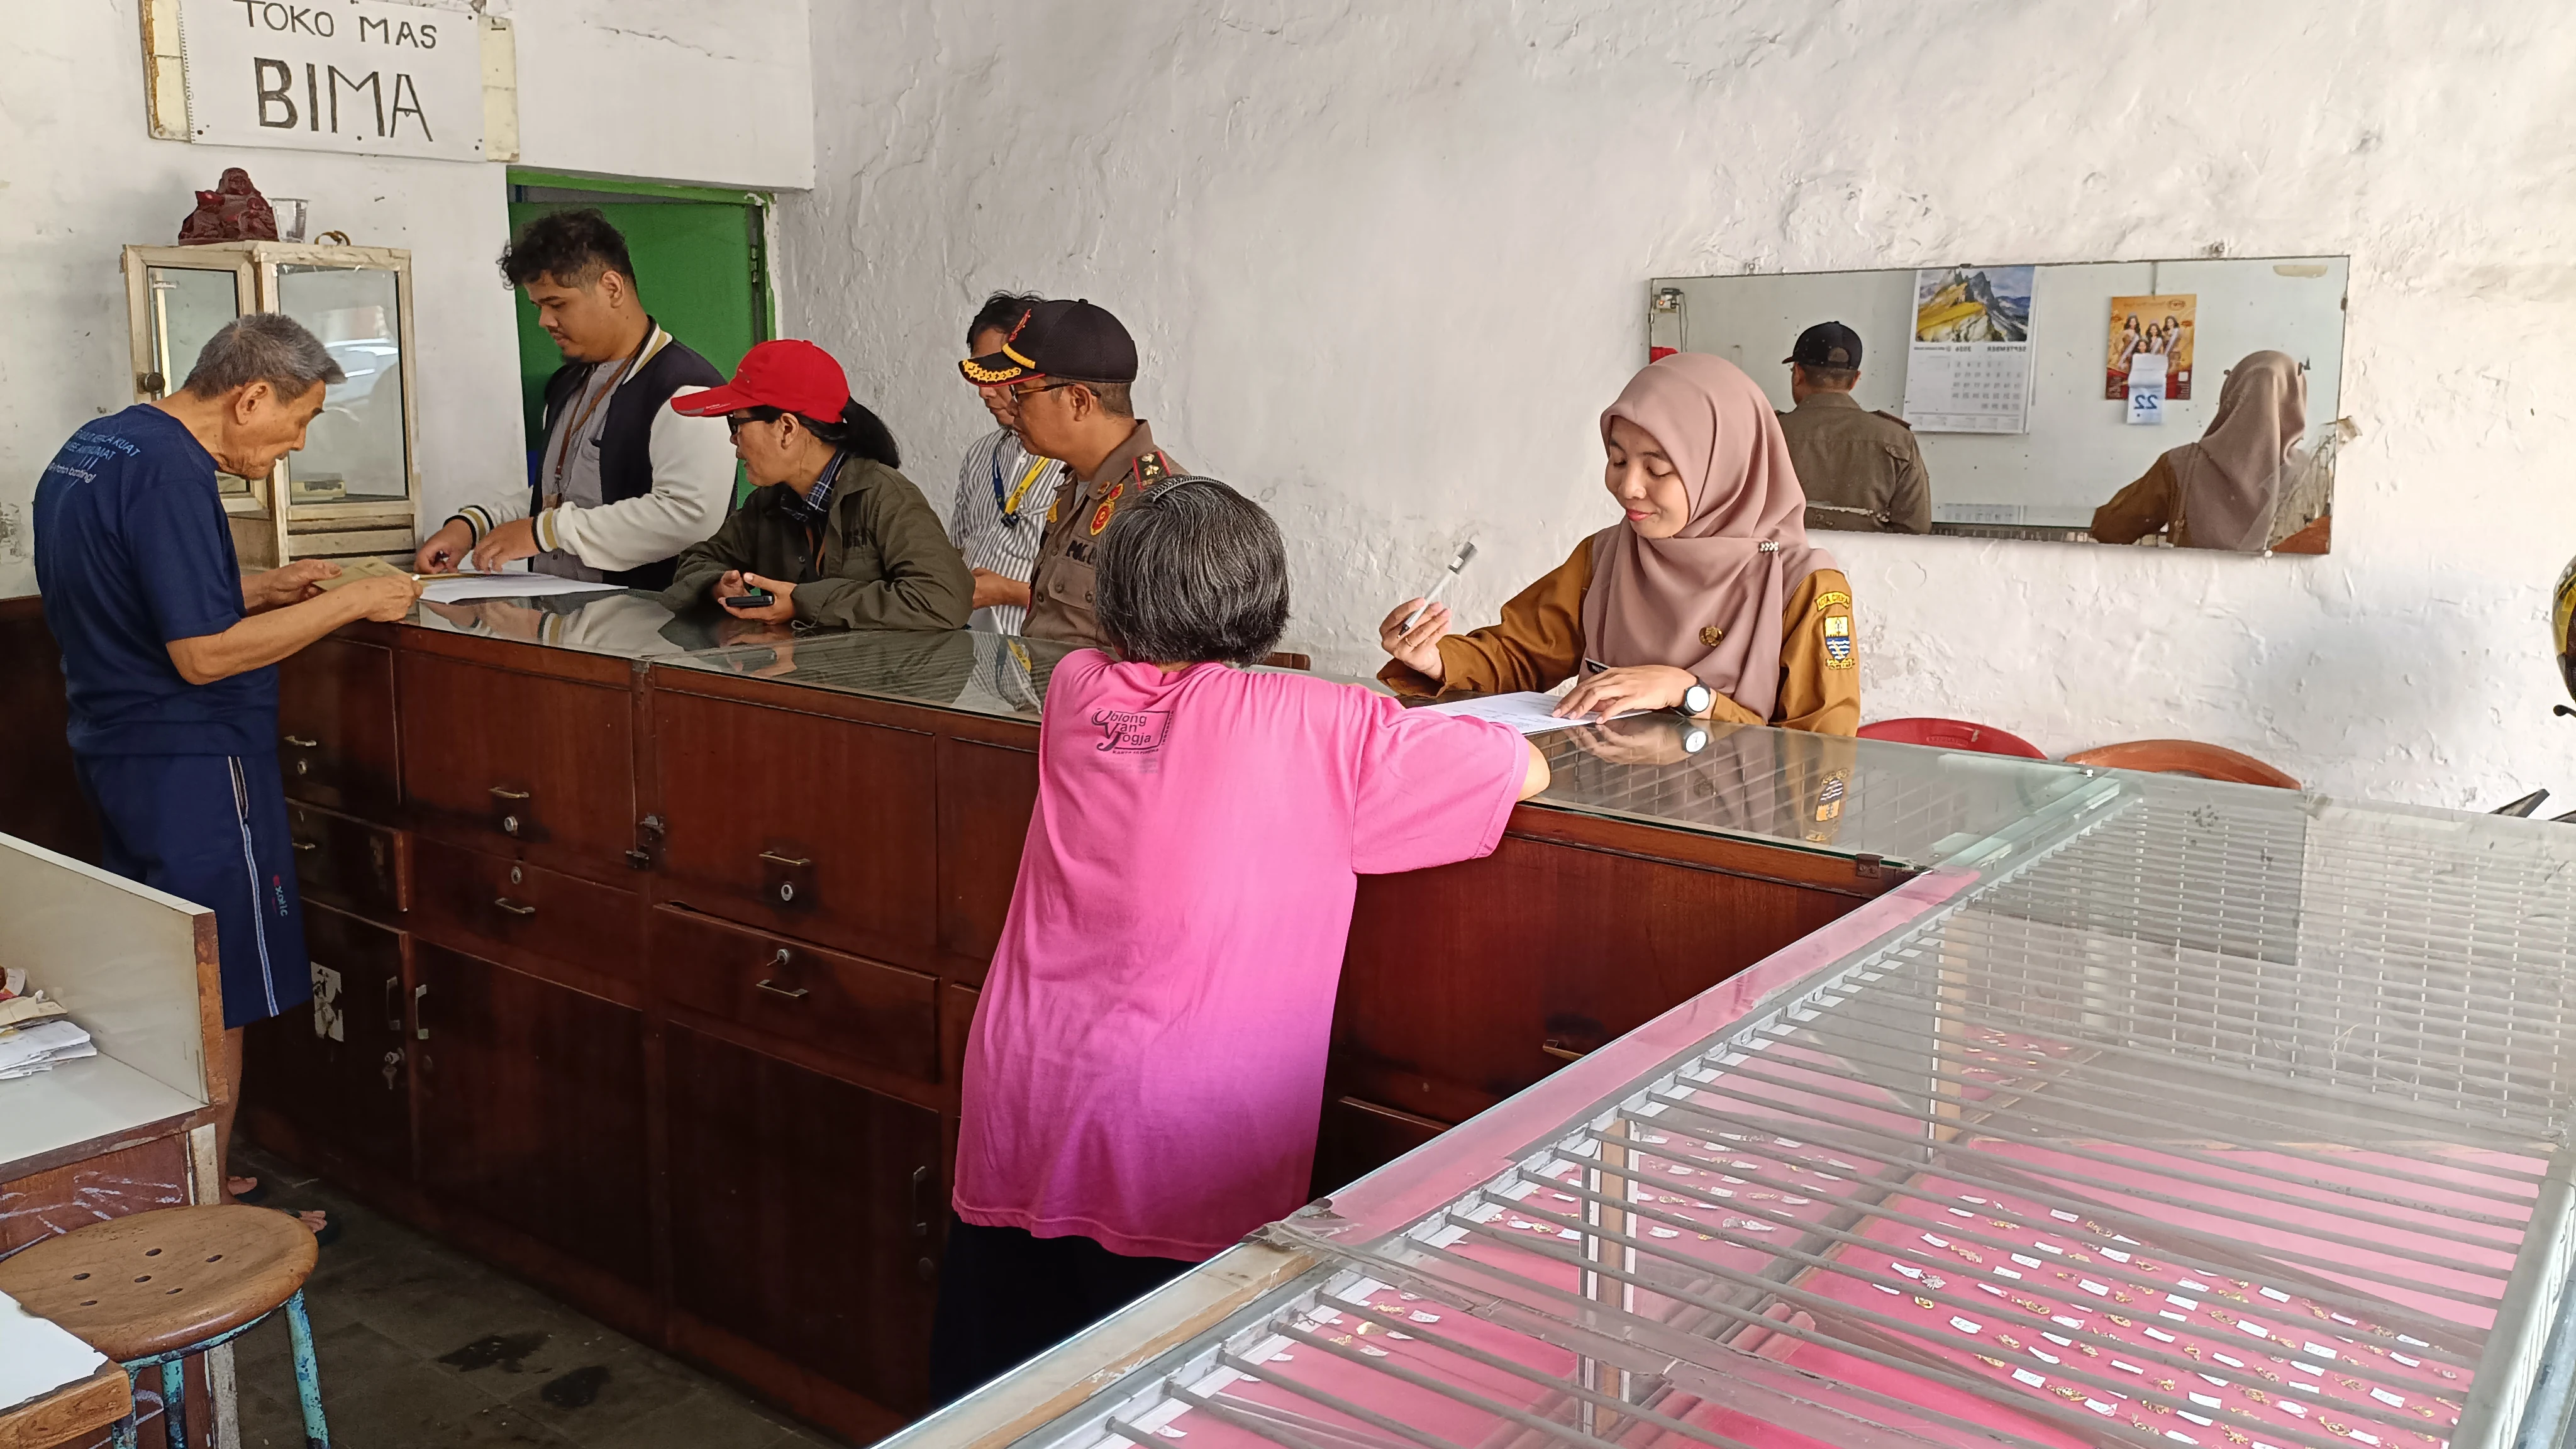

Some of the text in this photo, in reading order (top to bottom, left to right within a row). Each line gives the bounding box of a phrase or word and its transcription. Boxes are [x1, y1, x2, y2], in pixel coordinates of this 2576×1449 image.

[233, 0, 438, 50] TOKO MAS
[253, 57, 433, 142] BIMA
[113, 437, 141, 457] KUAT
[1091, 708, 1147, 726] Oblong
[1102, 723, 1137, 739] Van
[1096, 731, 1152, 752] Jogja
